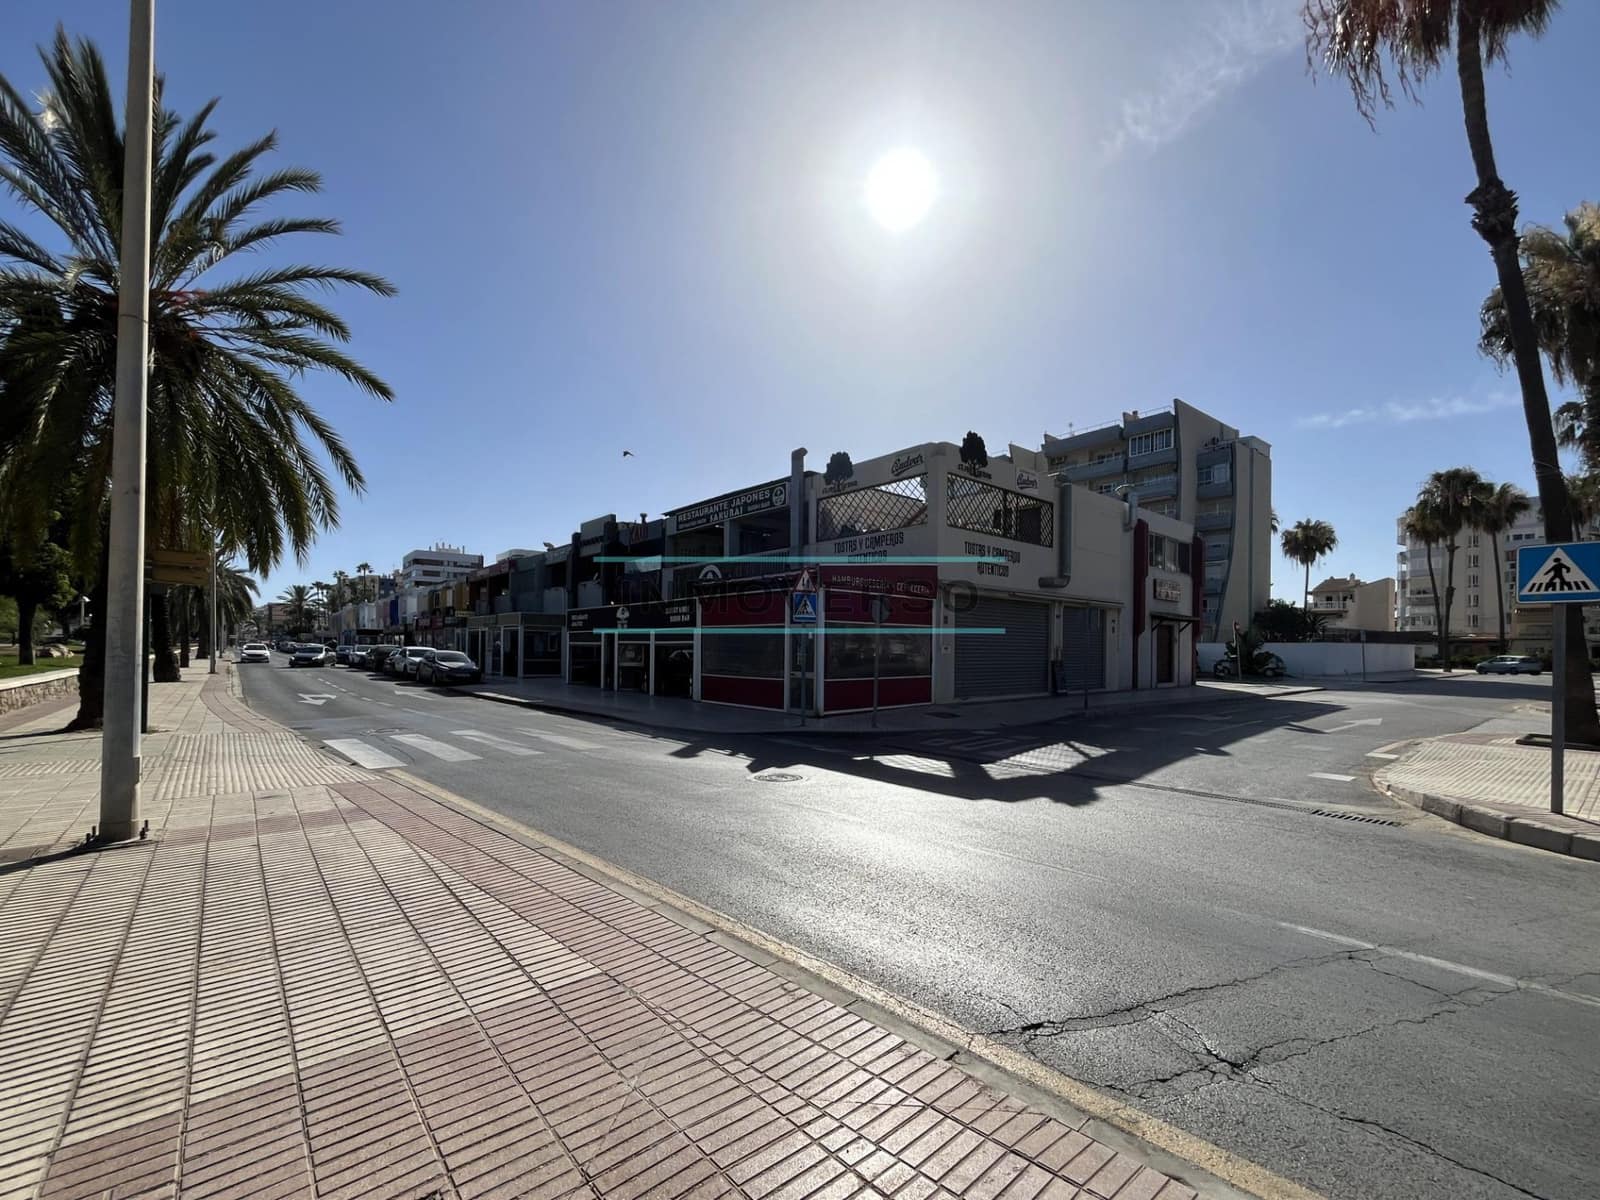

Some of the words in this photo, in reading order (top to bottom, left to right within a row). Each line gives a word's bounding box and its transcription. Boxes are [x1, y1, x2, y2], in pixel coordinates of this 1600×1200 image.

[678, 502, 729, 523] RESTAURANTE
[710, 506, 743, 524] SAKURAI
[834, 537, 857, 555] TOSTAS
[865, 532, 904, 551] CAMPEROS
